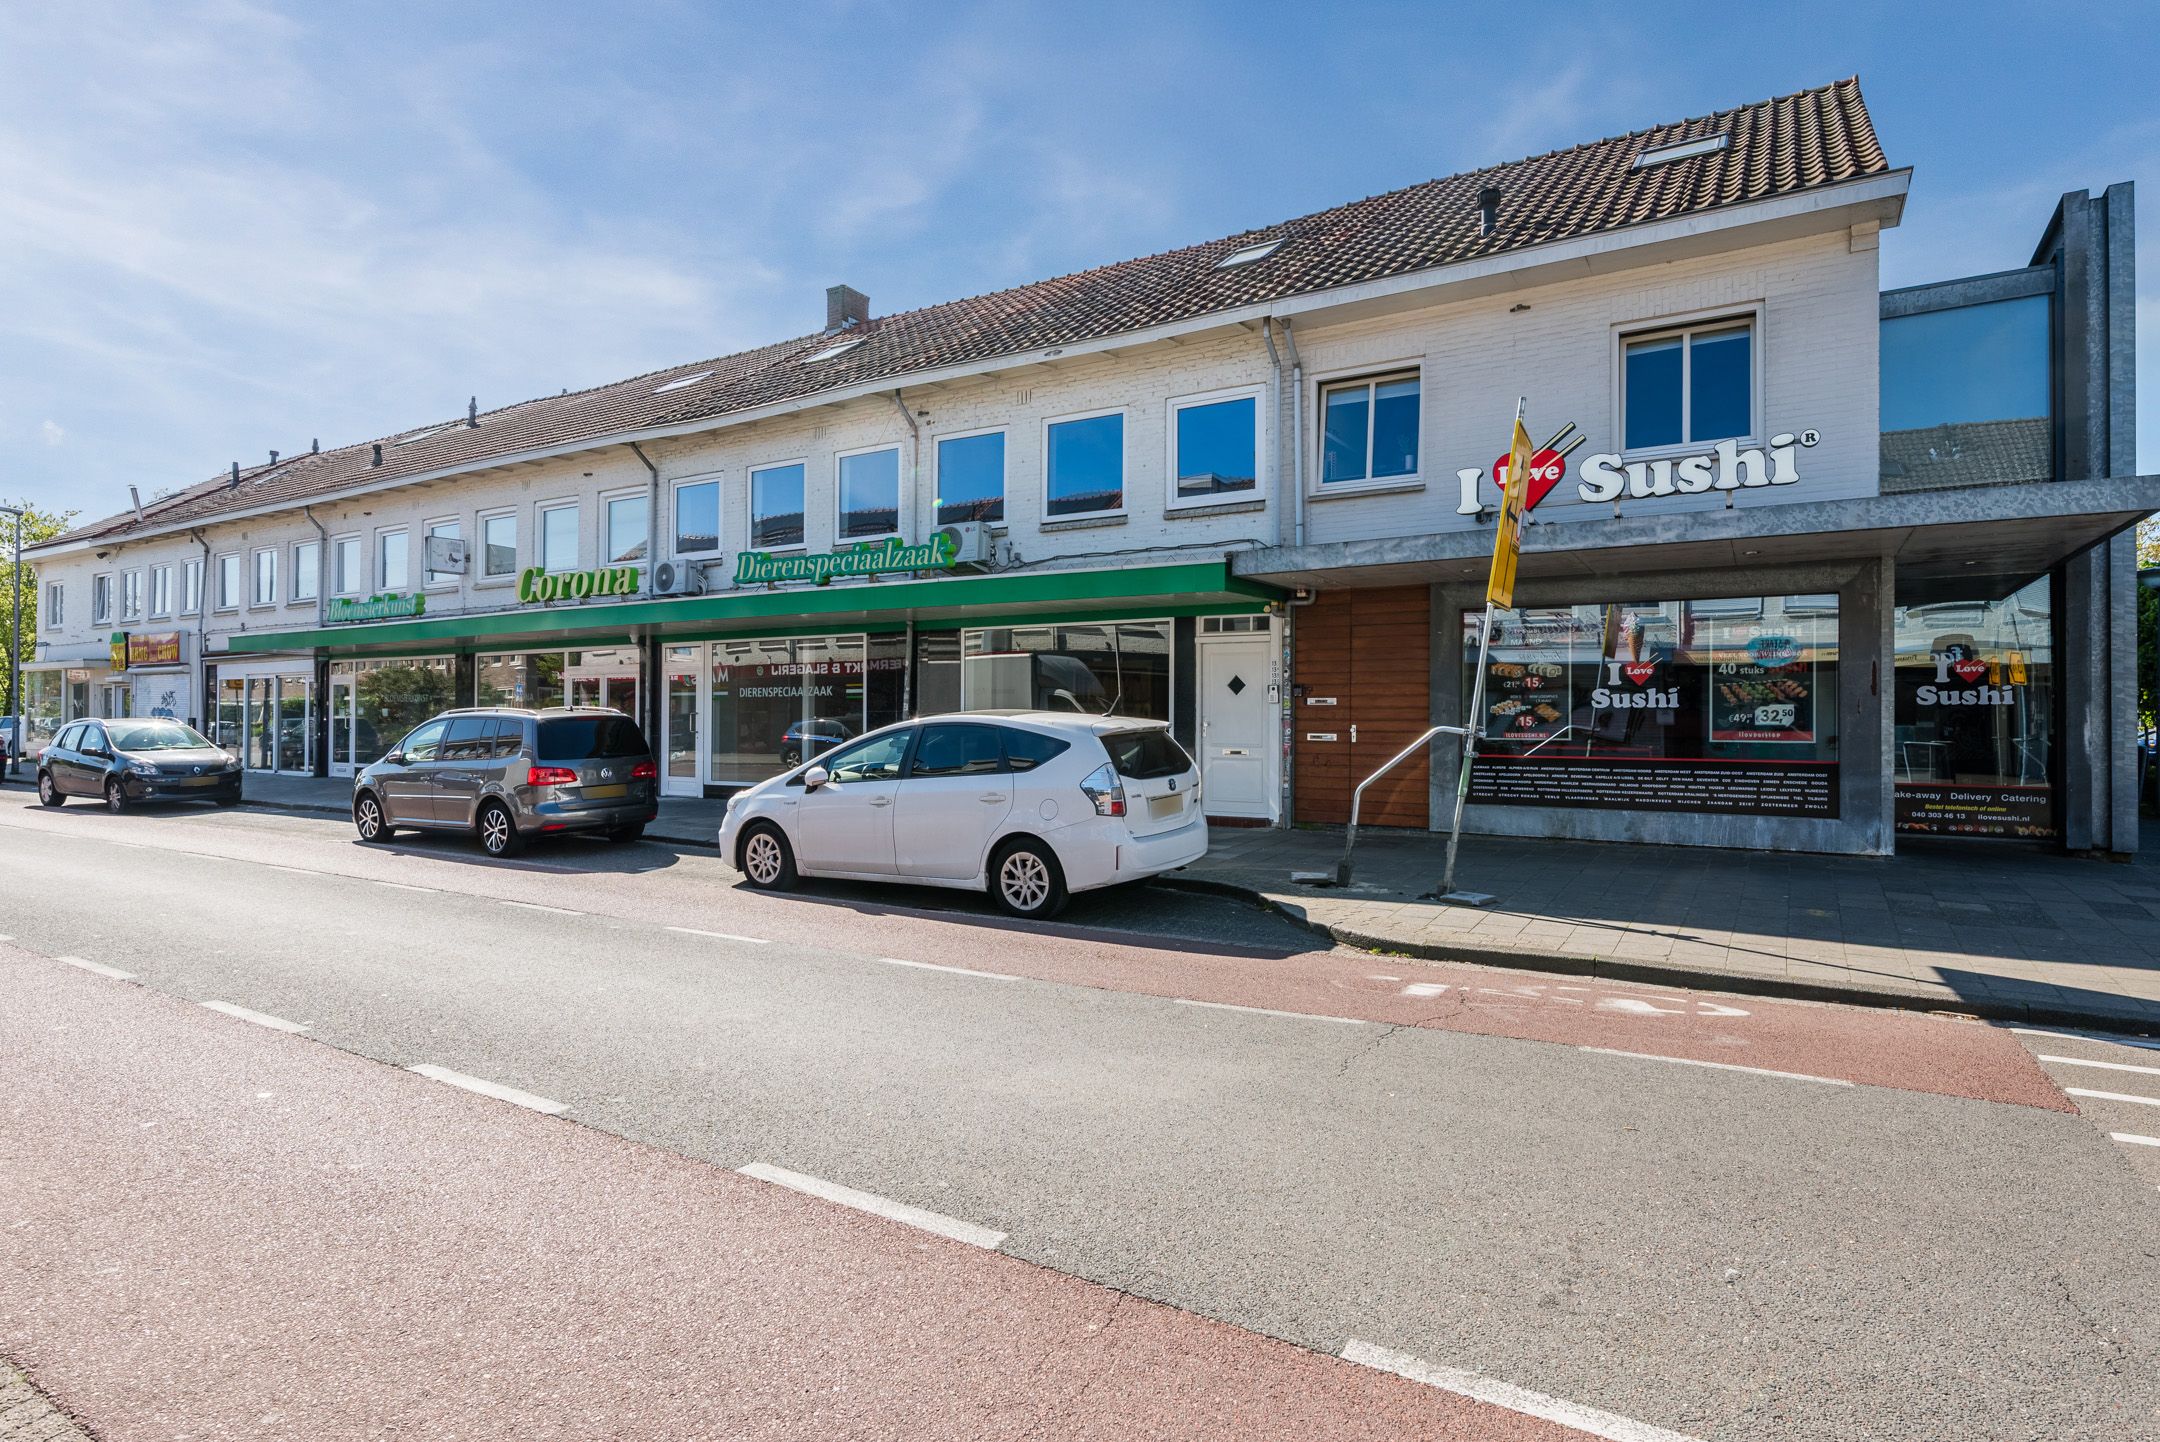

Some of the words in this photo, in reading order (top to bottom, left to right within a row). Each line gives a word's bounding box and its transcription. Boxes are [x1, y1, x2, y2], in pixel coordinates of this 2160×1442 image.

[1456, 468, 1484, 515] I
[1498, 465, 1560, 484] Lve
[1578, 433, 1800, 502] Sushi
[738, 534, 947, 582] Dierenspeciaalzaak
[515, 566, 638, 604] Corona
[330, 594, 417, 621] Bloemsierkunst
[1608, 662, 1622, 686] I
[1626, 666, 1653, 675] Love
[1718, 662, 1736, 674] 40
[1740, 666, 1765, 674] stuks
[1956, 664, 1986, 672] Love
[740, 686, 832, 698] DIERENSPECIAAZAAK
[1592, 687, 1680, 708] Sushi
[1916, 685, 2015, 706] Sushi
[1894, 792, 1942, 800] ake-away
[1950, 792, 1992, 802] Delivery
[2001, 794, 2046, 804] Catering
